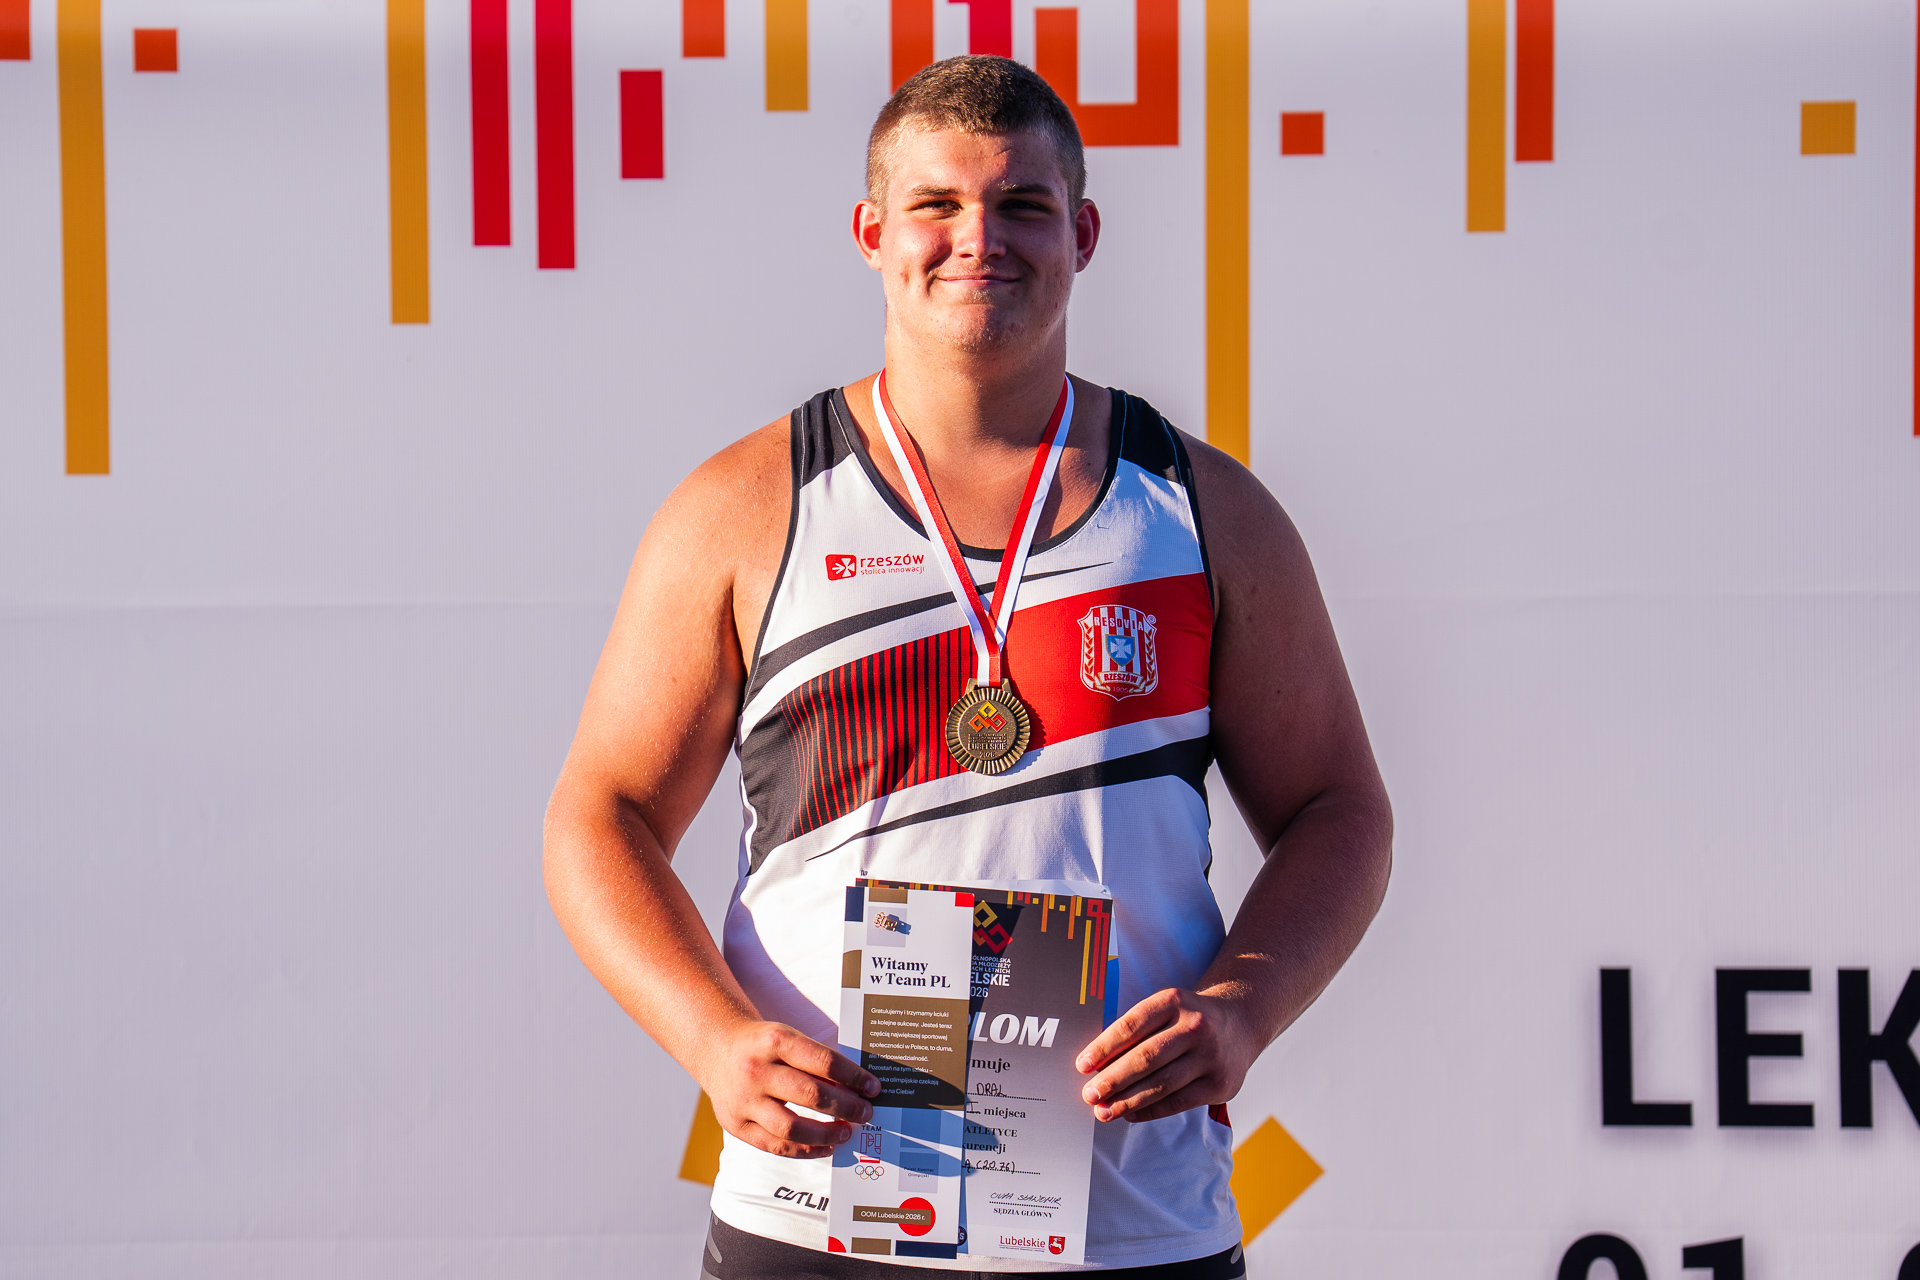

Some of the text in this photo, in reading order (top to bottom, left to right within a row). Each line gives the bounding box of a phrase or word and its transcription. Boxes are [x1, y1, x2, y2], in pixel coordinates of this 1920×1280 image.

[860, 553, 924, 568] rzeszów
[888, 566, 925, 575] innowacji
[1094, 616, 1144, 631] RESOVIA
[1103, 672, 1139, 684] RZESZÓW
[871, 956, 929, 975] Witamy
[869, 972, 951, 988] w Team PL
[870, 1007, 904, 1016] Gratulujemy
[906, 1009, 934, 1017] trzymamy
[869, 1030, 948, 1041] częścią największej sportowej
[968, 1011, 1060, 1048] LOM
[1600, 966, 1920, 1128] LEK
[966, 1058, 1011, 1073] muje
[984, 1106, 1026, 1119] miejsca
[964, 1125, 1018, 1138] ATLETYCE
[860, 1210, 877, 1218] OOM
[877, 1211, 905, 1219] Lubelskie
[993, 1207, 1053, 1219] SĘDZIA GŁÓWNY
[999, 1235, 1046, 1248] Lubelskie
